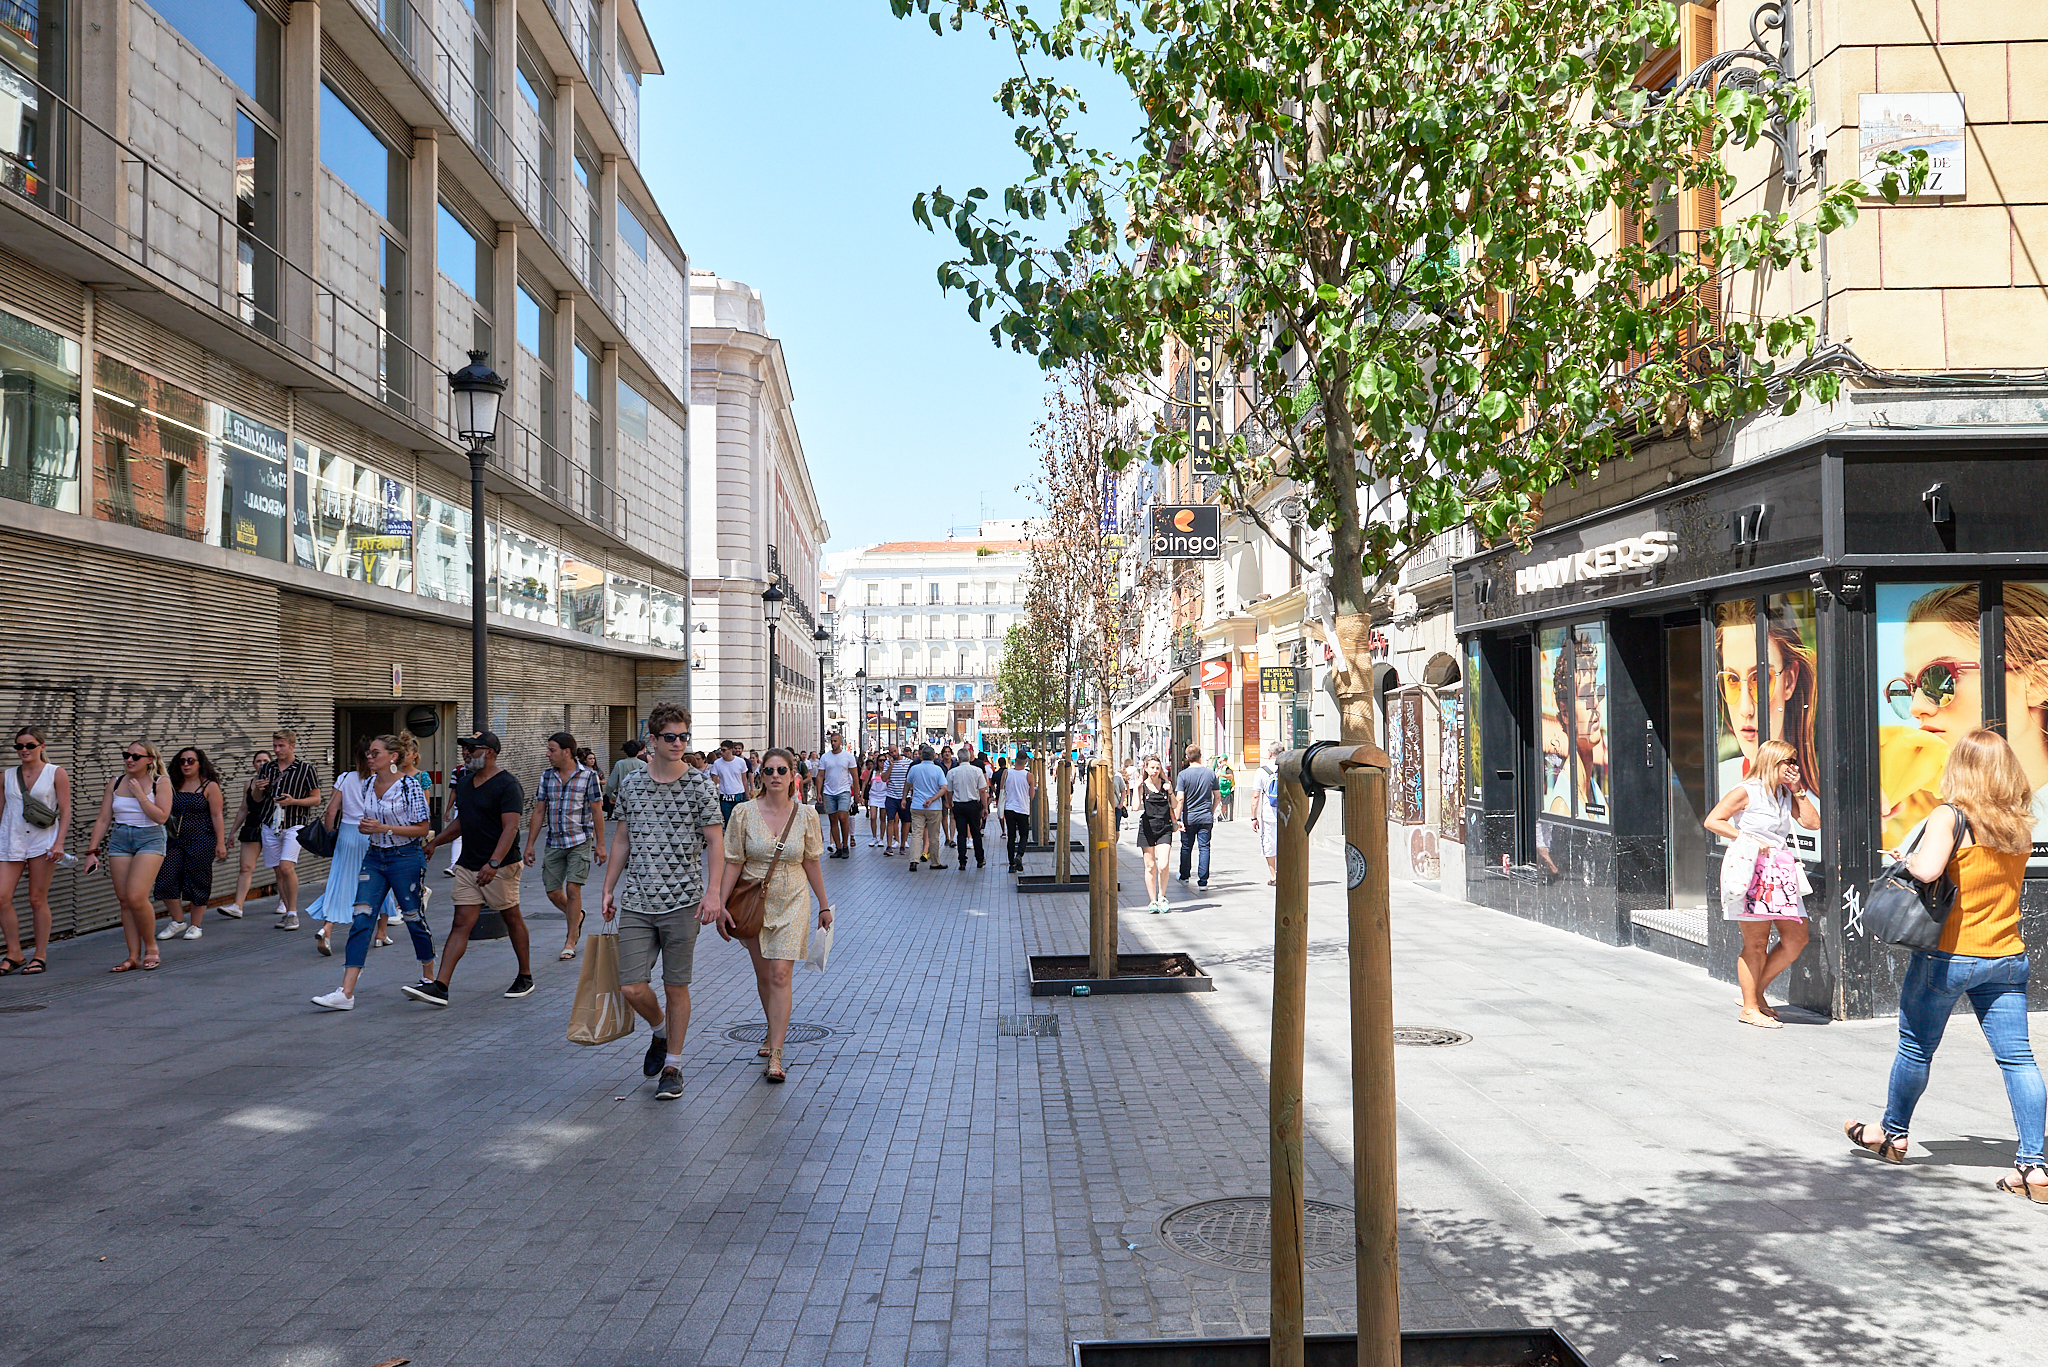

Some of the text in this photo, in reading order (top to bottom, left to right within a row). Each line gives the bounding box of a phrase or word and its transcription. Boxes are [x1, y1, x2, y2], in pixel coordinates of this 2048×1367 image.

[1933, 157, 1951, 168] DE
[1196, 336, 1212, 451] HOSTAL
[1155, 531, 1217, 554] bingo
[1516, 531, 1678, 596] HAWKERS
